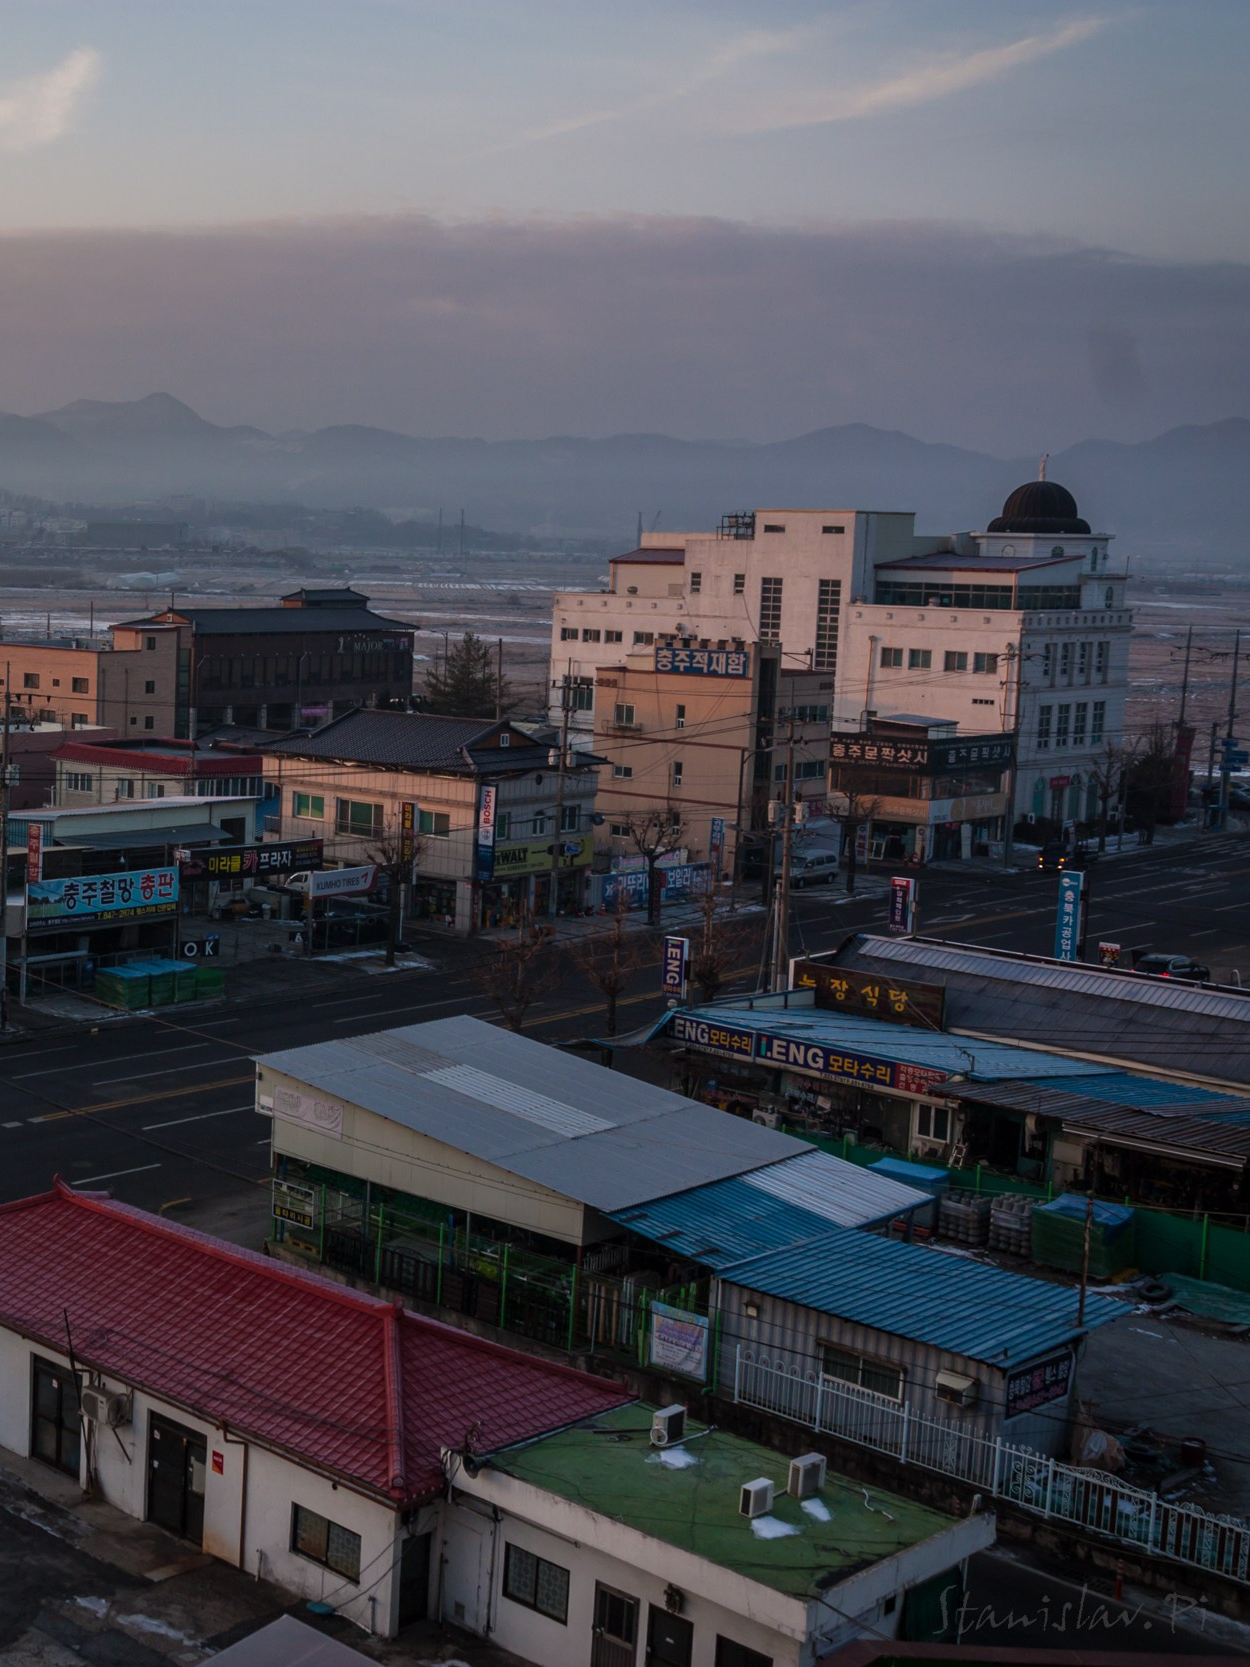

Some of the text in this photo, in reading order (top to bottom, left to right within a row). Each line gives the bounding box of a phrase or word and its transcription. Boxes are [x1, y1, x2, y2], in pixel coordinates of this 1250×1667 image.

[353, 641, 383, 652] MAJOR
[657, 649, 746, 674] 충주적재함
[832, 743, 928, 764] 충주문짝샷시
[483, 790, 492, 824] BOSCH
[494, 847, 528, 865] EWALT
[63, 872, 175, 910] 충주철망 총판
[316, 877, 360, 891] KUMHO TIRES
[1059, 890, 1074, 961] 충북카공업사
[710, 1029, 751, 1051] 모타수리
[828, 1056, 891, 1084] 모타수리
